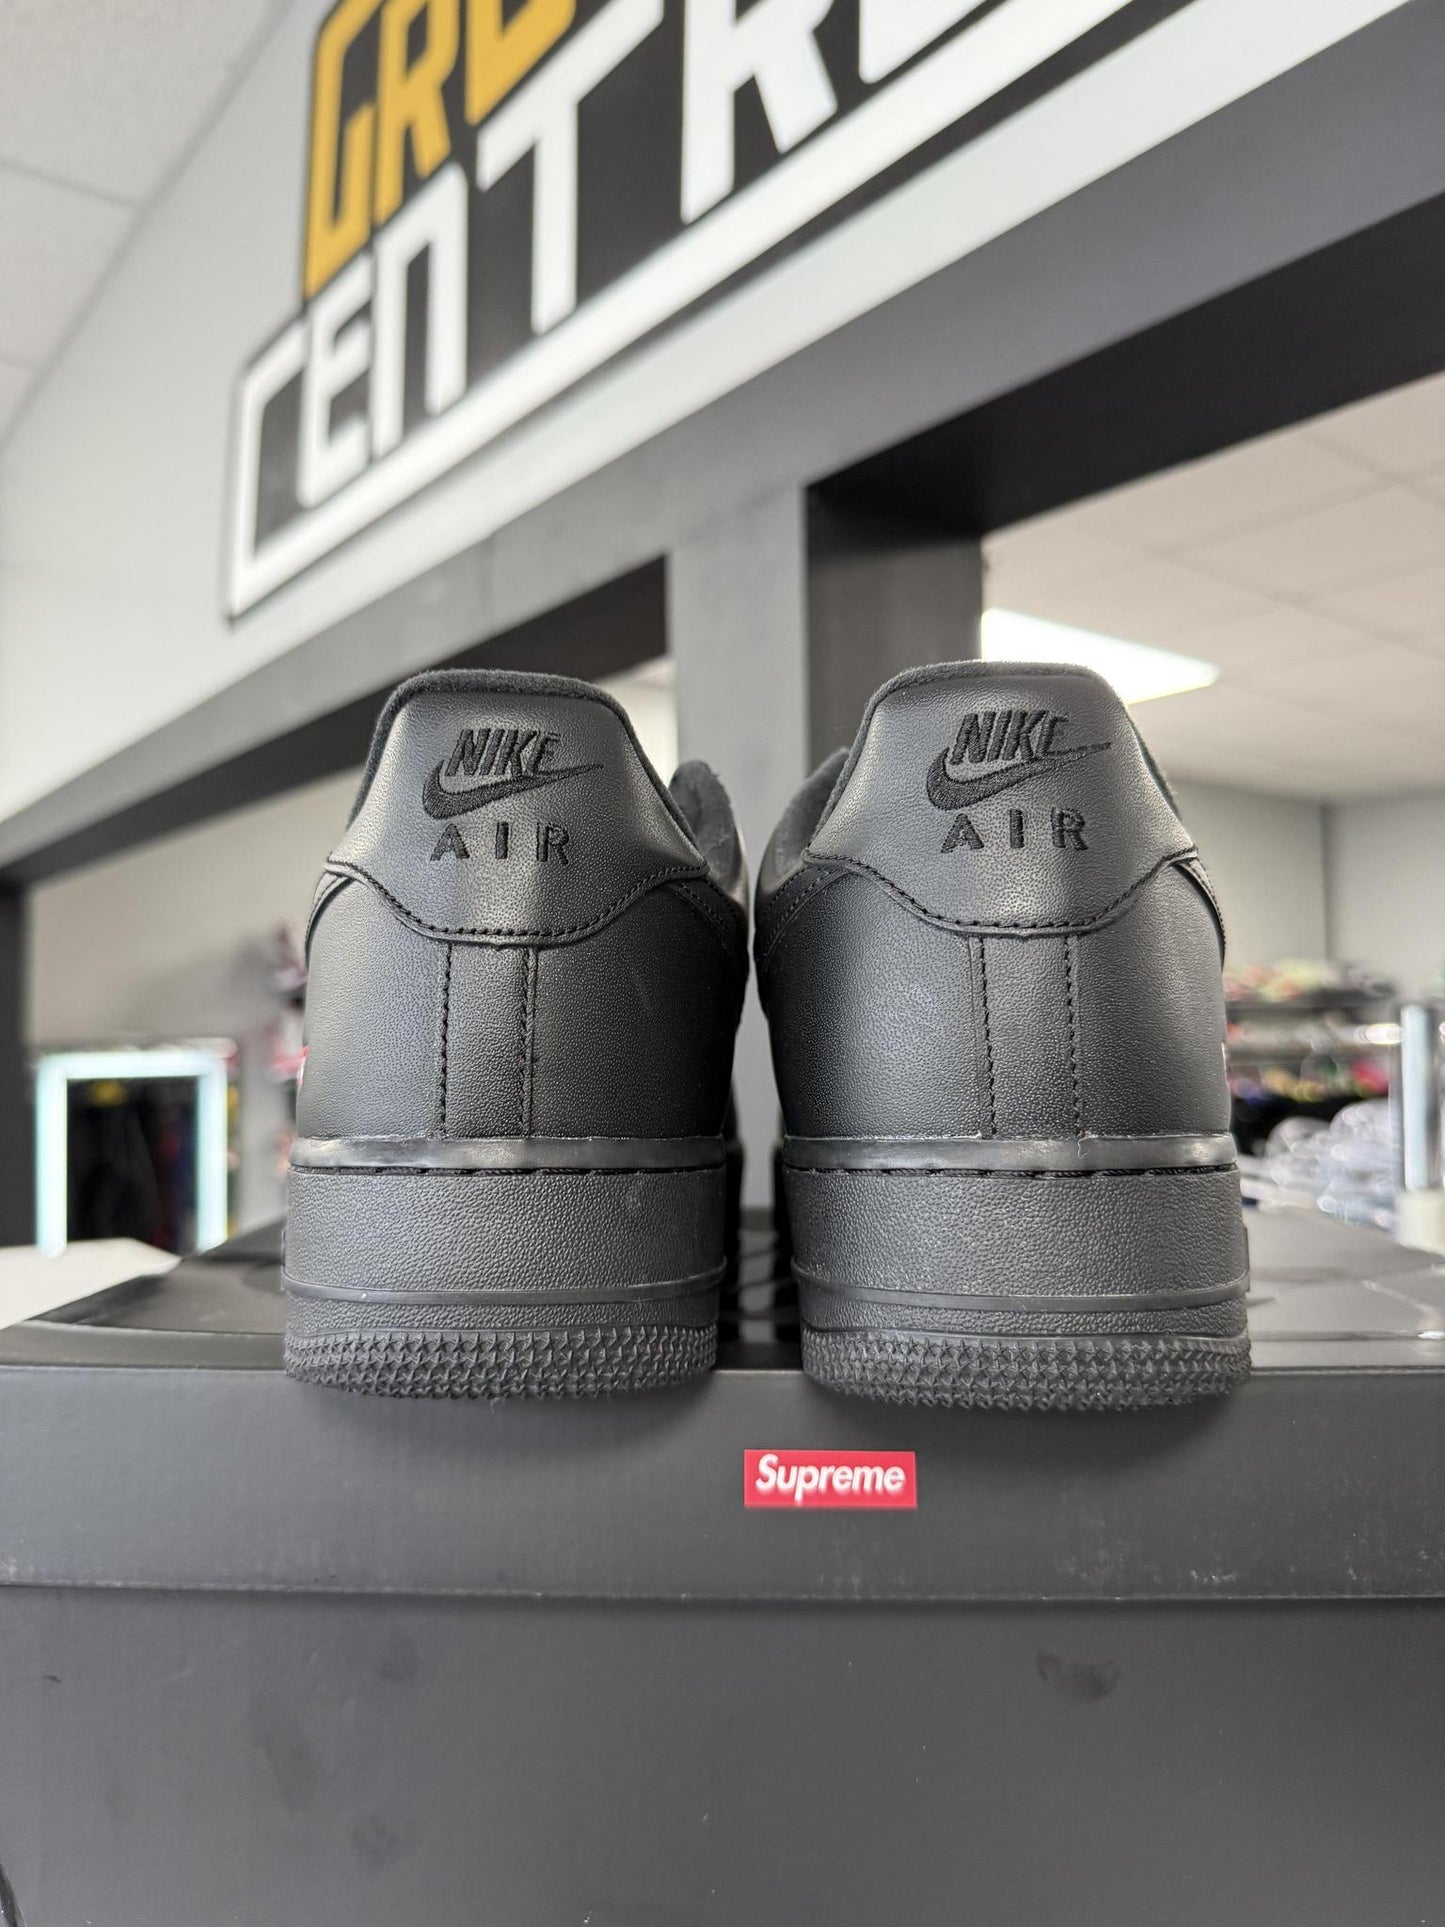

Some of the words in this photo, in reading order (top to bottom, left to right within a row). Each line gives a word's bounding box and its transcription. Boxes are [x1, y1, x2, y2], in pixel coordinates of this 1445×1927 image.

[445, 728, 562, 777] NIKE
[950, 709, 1069, 765] NIKE
[429, 821, 570, 865] AIR
[940, 807, 1088, 854] AIR
[755, 1453, 906, 1506] Supreme
